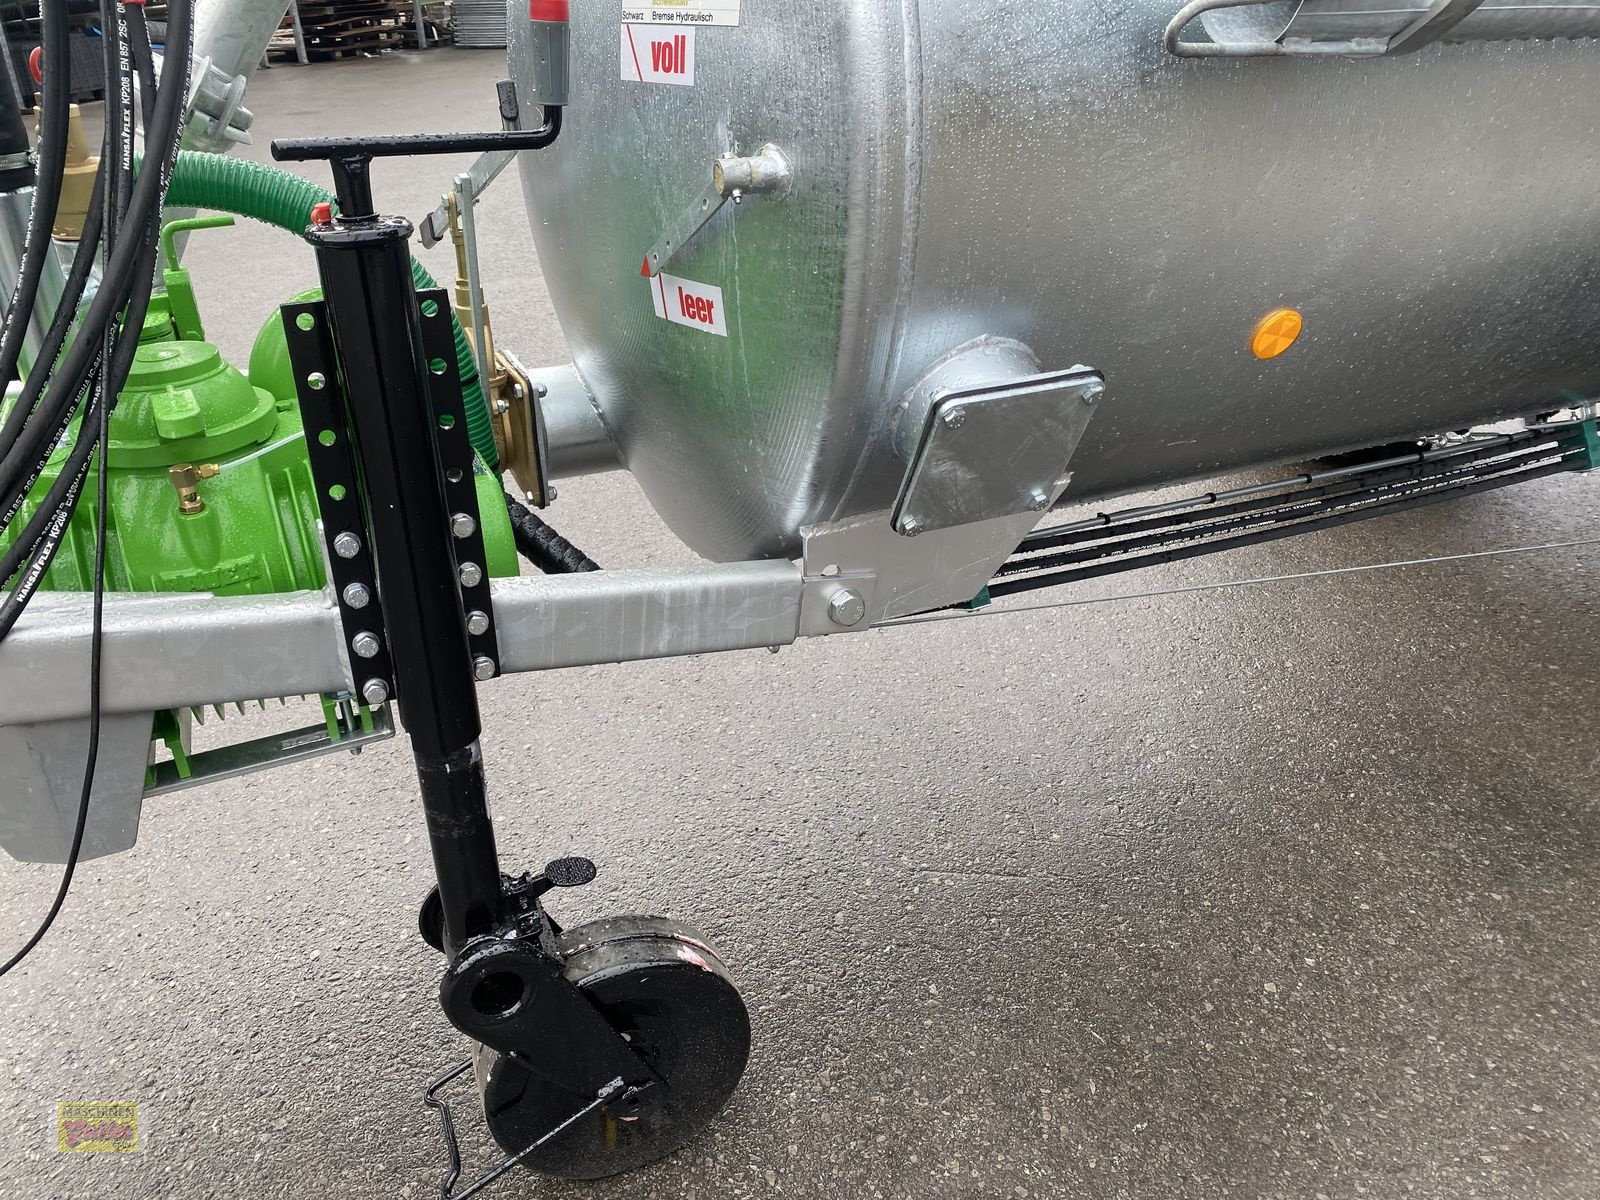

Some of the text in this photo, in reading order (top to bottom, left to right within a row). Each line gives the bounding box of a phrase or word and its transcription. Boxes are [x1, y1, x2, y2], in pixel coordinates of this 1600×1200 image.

[118, 19, 128, 38] 2SC
[622, 10, 714, 24] Schwarz Bremse Hydraulisch
[119, 41, 129, 58] 857
[651, 35, 686, 74] voll
[121, 58, 130, 71] EN
[122, 77, 131, 104] KP208
[678, 286, 714, 325] leer
[3, 509, 15, 523] EN
[44, 442, 56, 457] WP
[49, 511, 68, 539] KP208
